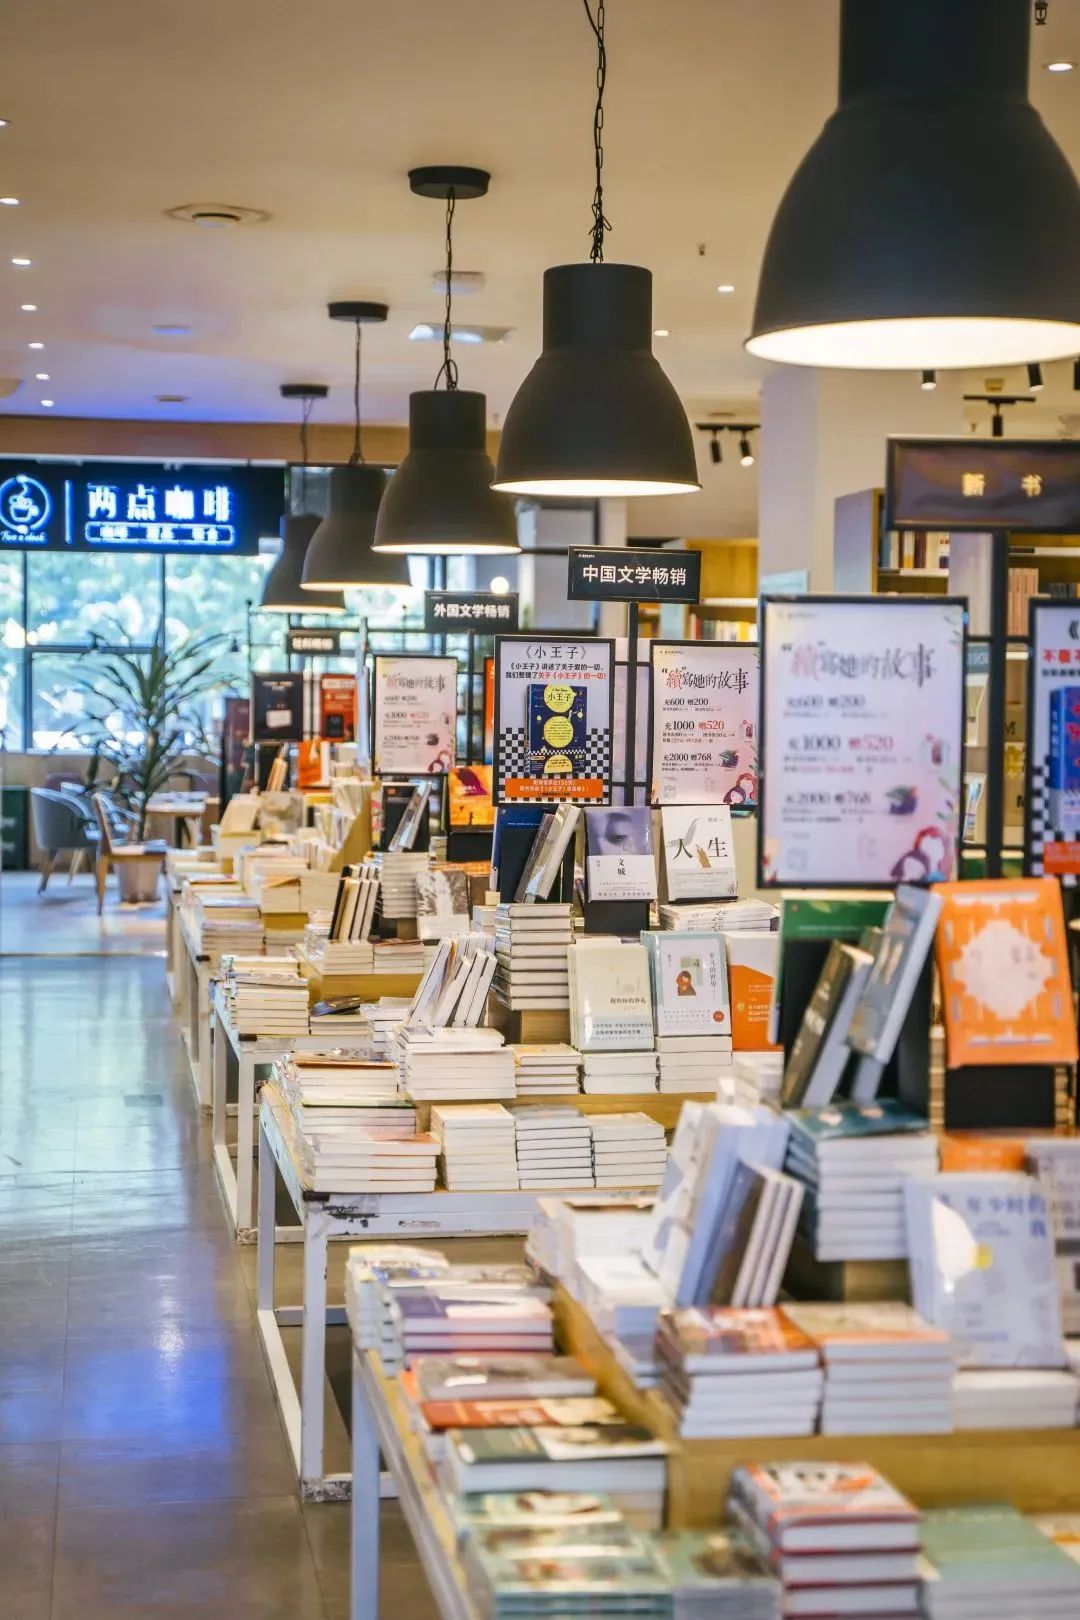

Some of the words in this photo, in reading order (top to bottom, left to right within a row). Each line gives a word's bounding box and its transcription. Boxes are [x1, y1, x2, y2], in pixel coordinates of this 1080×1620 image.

[87, 483, 234, 522] 两点咖啡
[582, 564, 687, 586] 中国文学畅销
[433, 603, 511, 619] 外国文学畅销
[525, 645, 587, 660] 《小王子》
[548, 692, 572, 702] 小王子
[665, 720, 695, 731] 充1000
[673, 837, 729, 860] 人生
[617, 858, 626, 875] 文城
